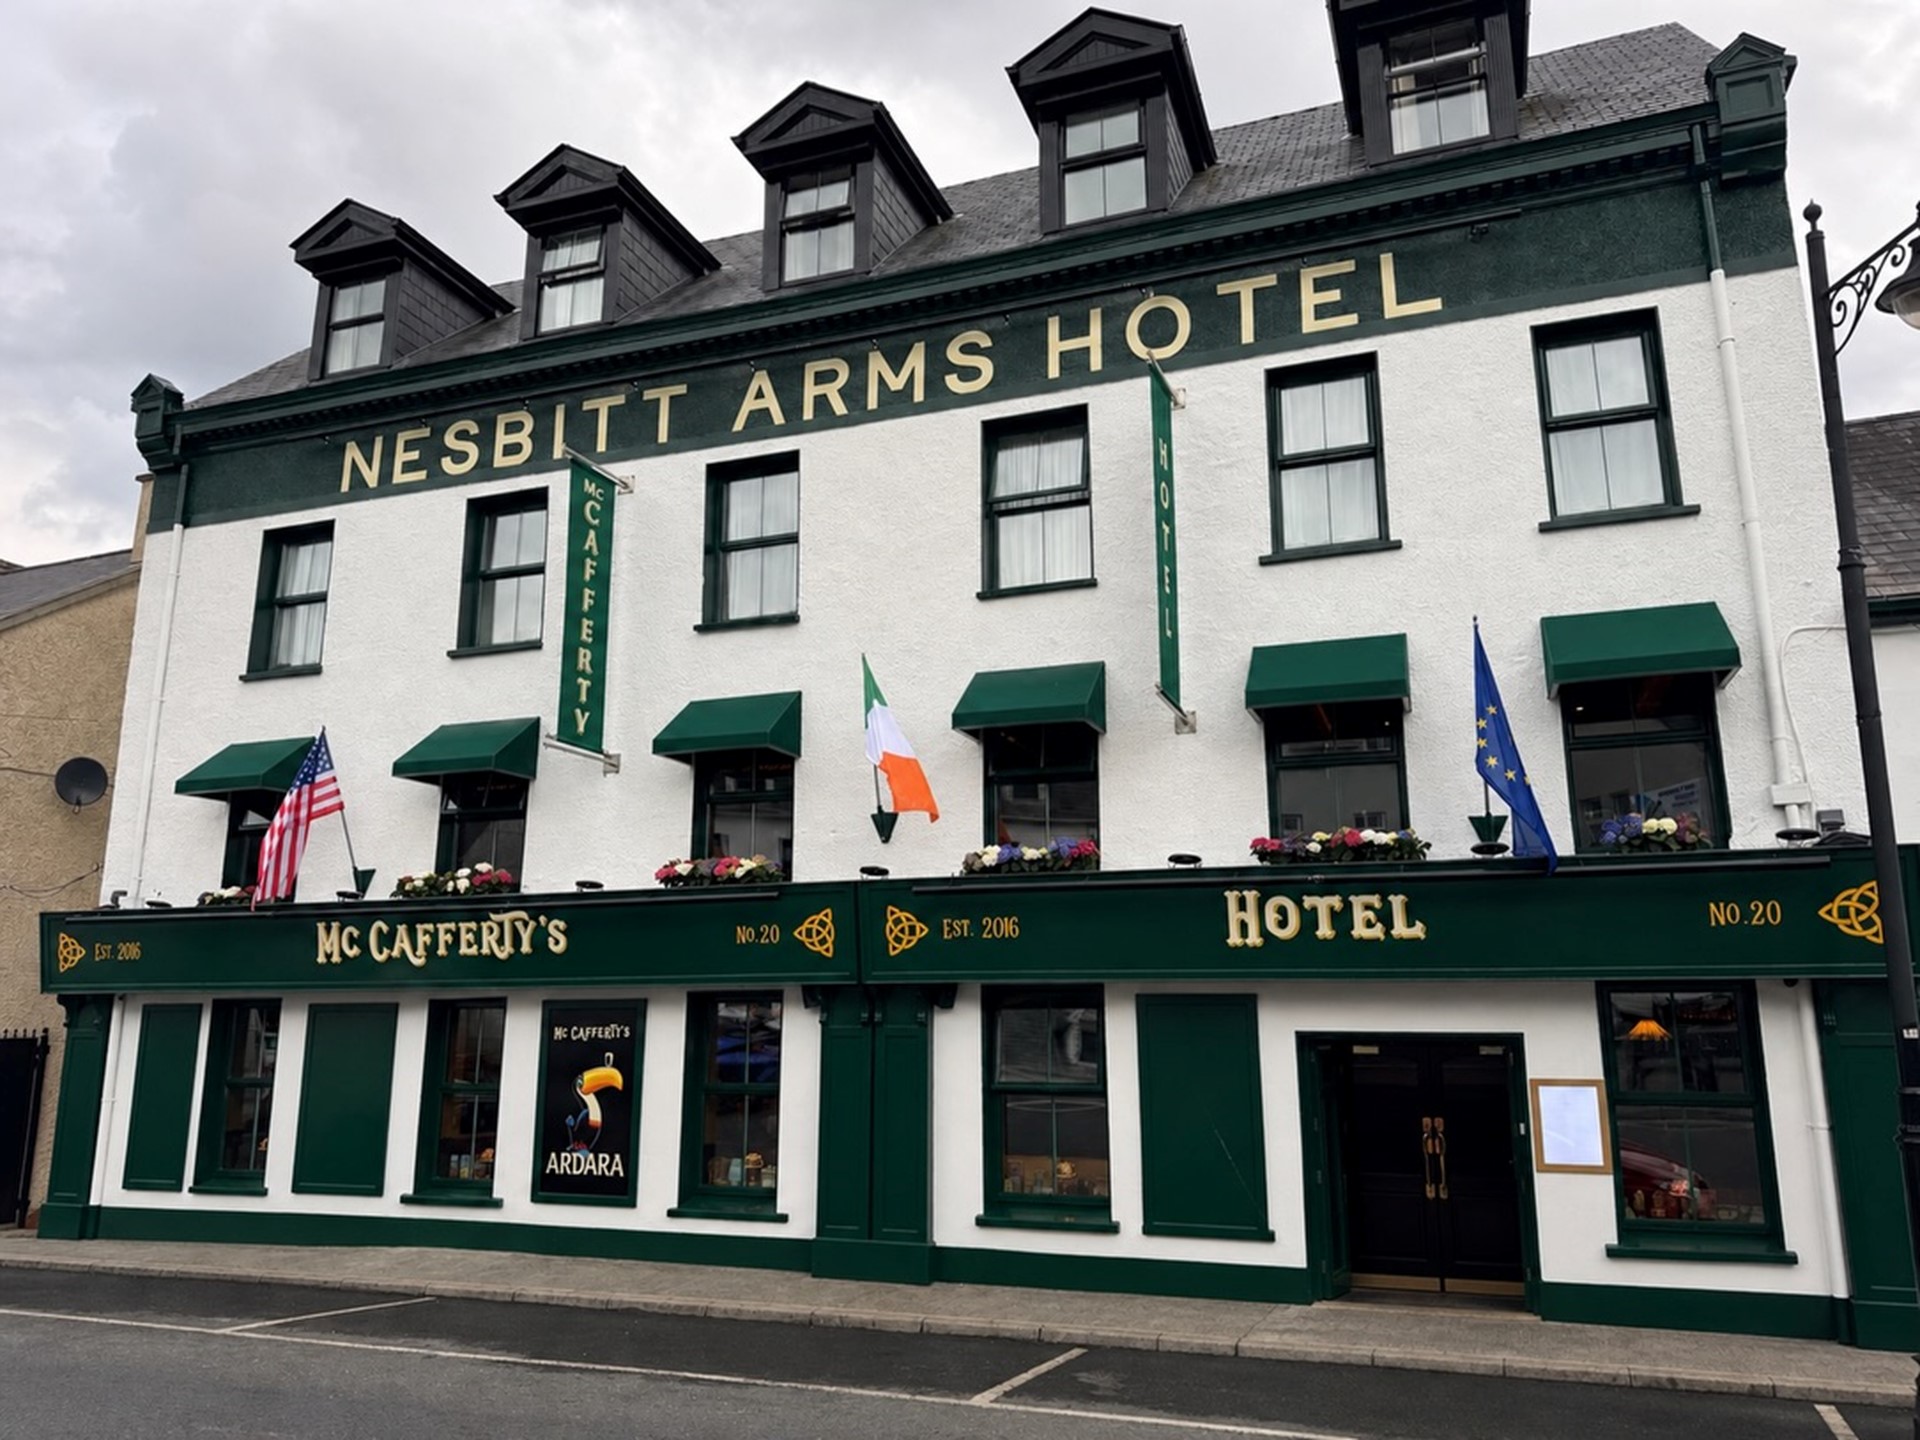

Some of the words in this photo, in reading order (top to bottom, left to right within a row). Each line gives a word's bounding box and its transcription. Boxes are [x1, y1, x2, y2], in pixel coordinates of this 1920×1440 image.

[341, 384, 688, 493] NESBITT
[731, 330, 995, 432] ARMS
[1047, 253, 1443, 379] HOTEL
[1158, 437, 1172, 638] HOTEL
[574, 500, 601, 736] CAFFERTY
[369, 910, 568, 967] CAFFERTY'S
[942, 918, 974, 940] EST.
[982, 916, 1020, 939] 2016
[1224, 889, 1426, 948] HOTEL
[571, 1023, 630, 1041] CAFFERTY'S
[545, 1152, 624, 1177] ARDARA
